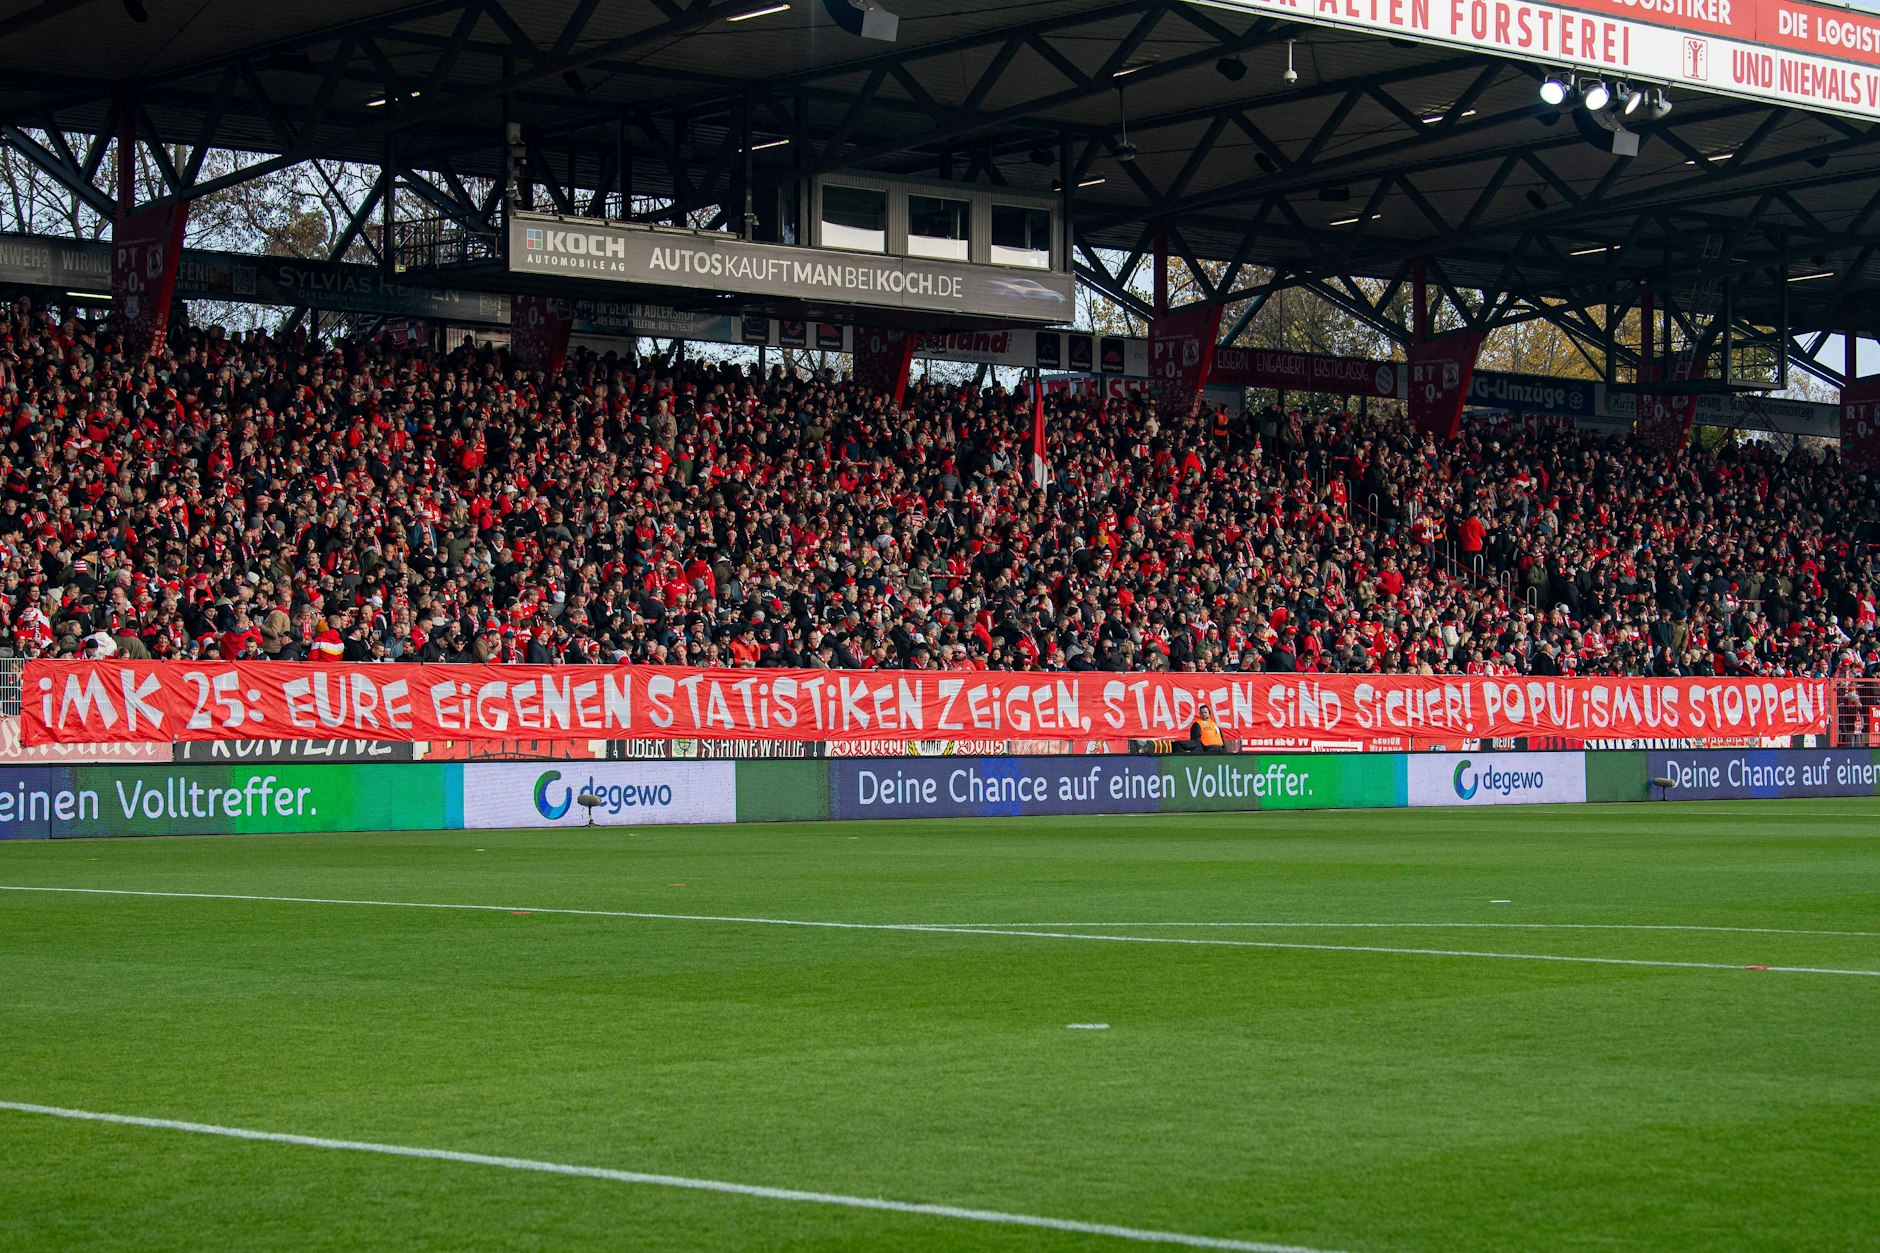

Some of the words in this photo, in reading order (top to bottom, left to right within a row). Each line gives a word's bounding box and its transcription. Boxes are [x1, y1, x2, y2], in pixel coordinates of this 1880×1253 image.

[1611, 0, 1732, 25] STIKER
[1778, 9, 1808, 39] DIE
[1450, 0, 1629, 65] FÖRSTEREI
[1733, 50, 1773, 88] UND
[1780, 59, 1861, 104] NIEMALS
[1866, 74, 1880, 109] V
[547, 230, 625, 258] KOCH
[61, 250, 89, 271] WIR
[176, 261, 209, 282] FEN!
[527, 253, 605, 270] AUTOMOBILE
[611, 261, 625, 272] AG
[278, 265, 372, 294] SYLVIAS
[182, 671, 263, 729] 25:
[282, 672, 412, 729] EURE
[1689, 682, 1828, 729] STOPPEN!
[858, 769, 937, 804] Deine
[948, 768, 1048, 803] Chance
[1058, 766, 1101, 801] auf
[1109, 768, 1176, 799] einen
[1185, 763, 1313, 798] Volltreffer.
[1483, 764, 1543, 796] degewo
[1666, 760, 1720, 788] Deine
[1727, 758, 1795, 787] Chance
[1802, 757, 1831, 786] auf
[0, 781, 99, 821] einen
[115, 776, 317, 819] Volltreffer.
[579, 776, 672, 814] degewo
